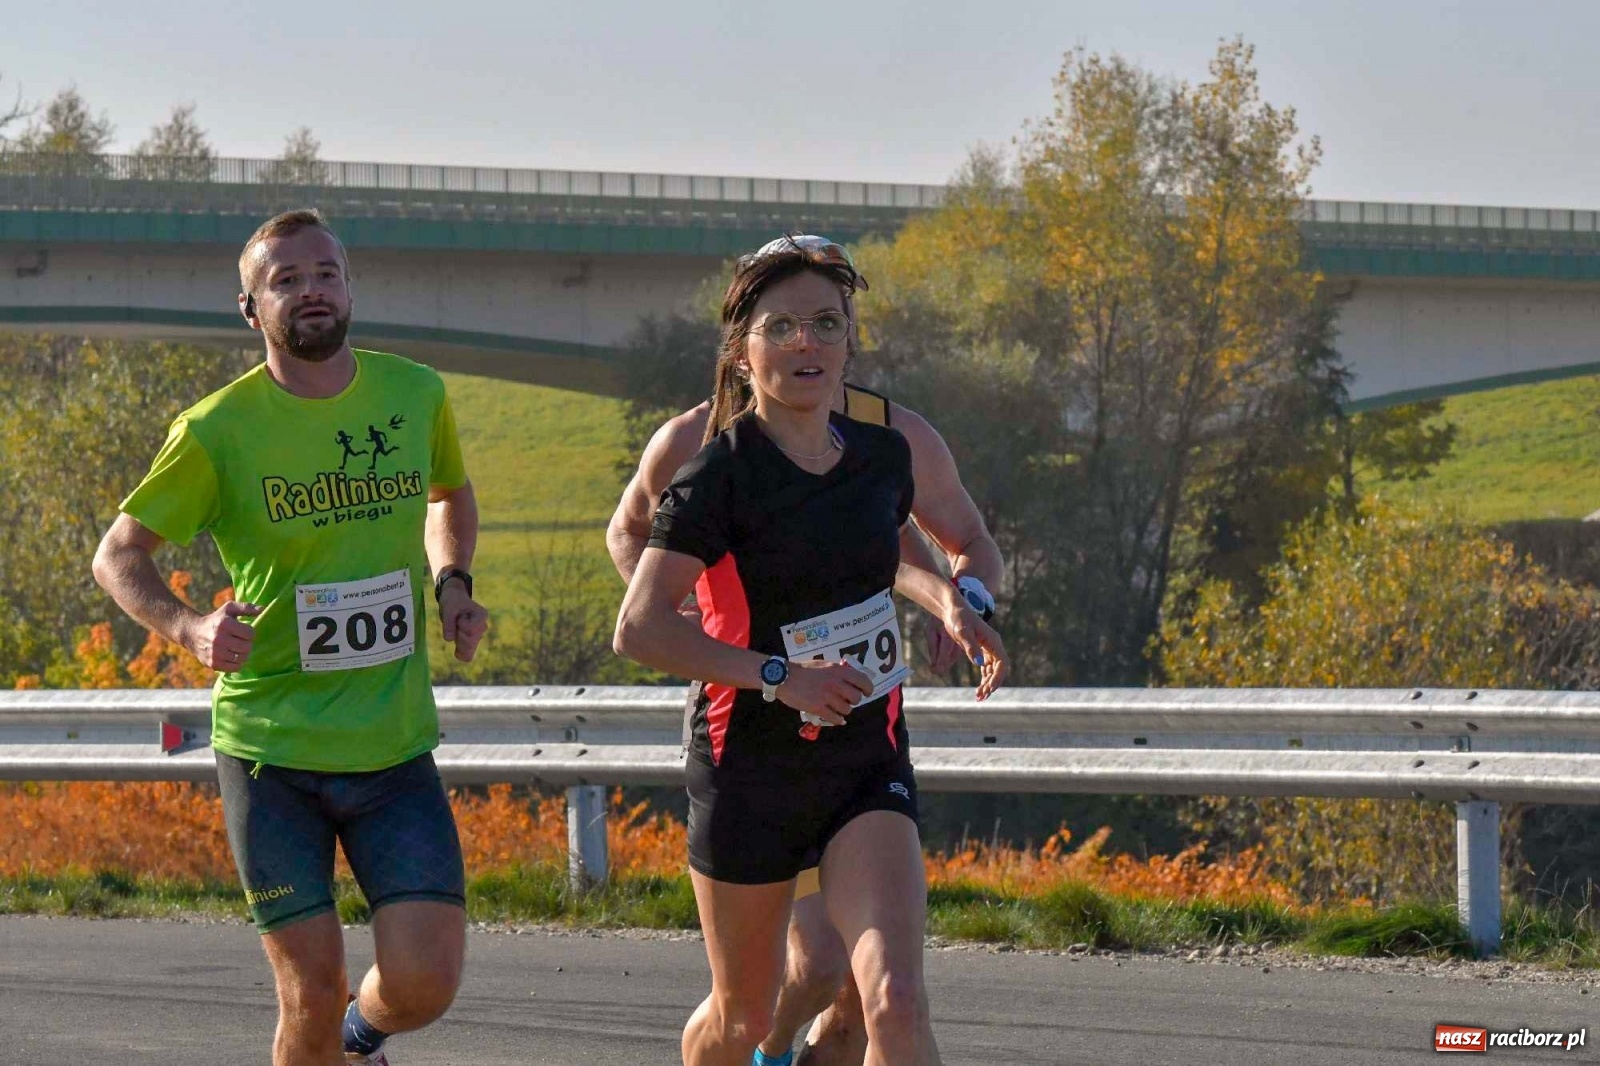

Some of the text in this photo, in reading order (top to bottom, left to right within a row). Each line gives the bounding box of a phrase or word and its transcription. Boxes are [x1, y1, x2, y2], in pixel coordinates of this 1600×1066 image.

[262, 471, 422, 522] Radlinioki
[312, 505, 393, 528] w biegu
[306, 604, 408, 655] 208
[812, 629, 897, 674] 79
